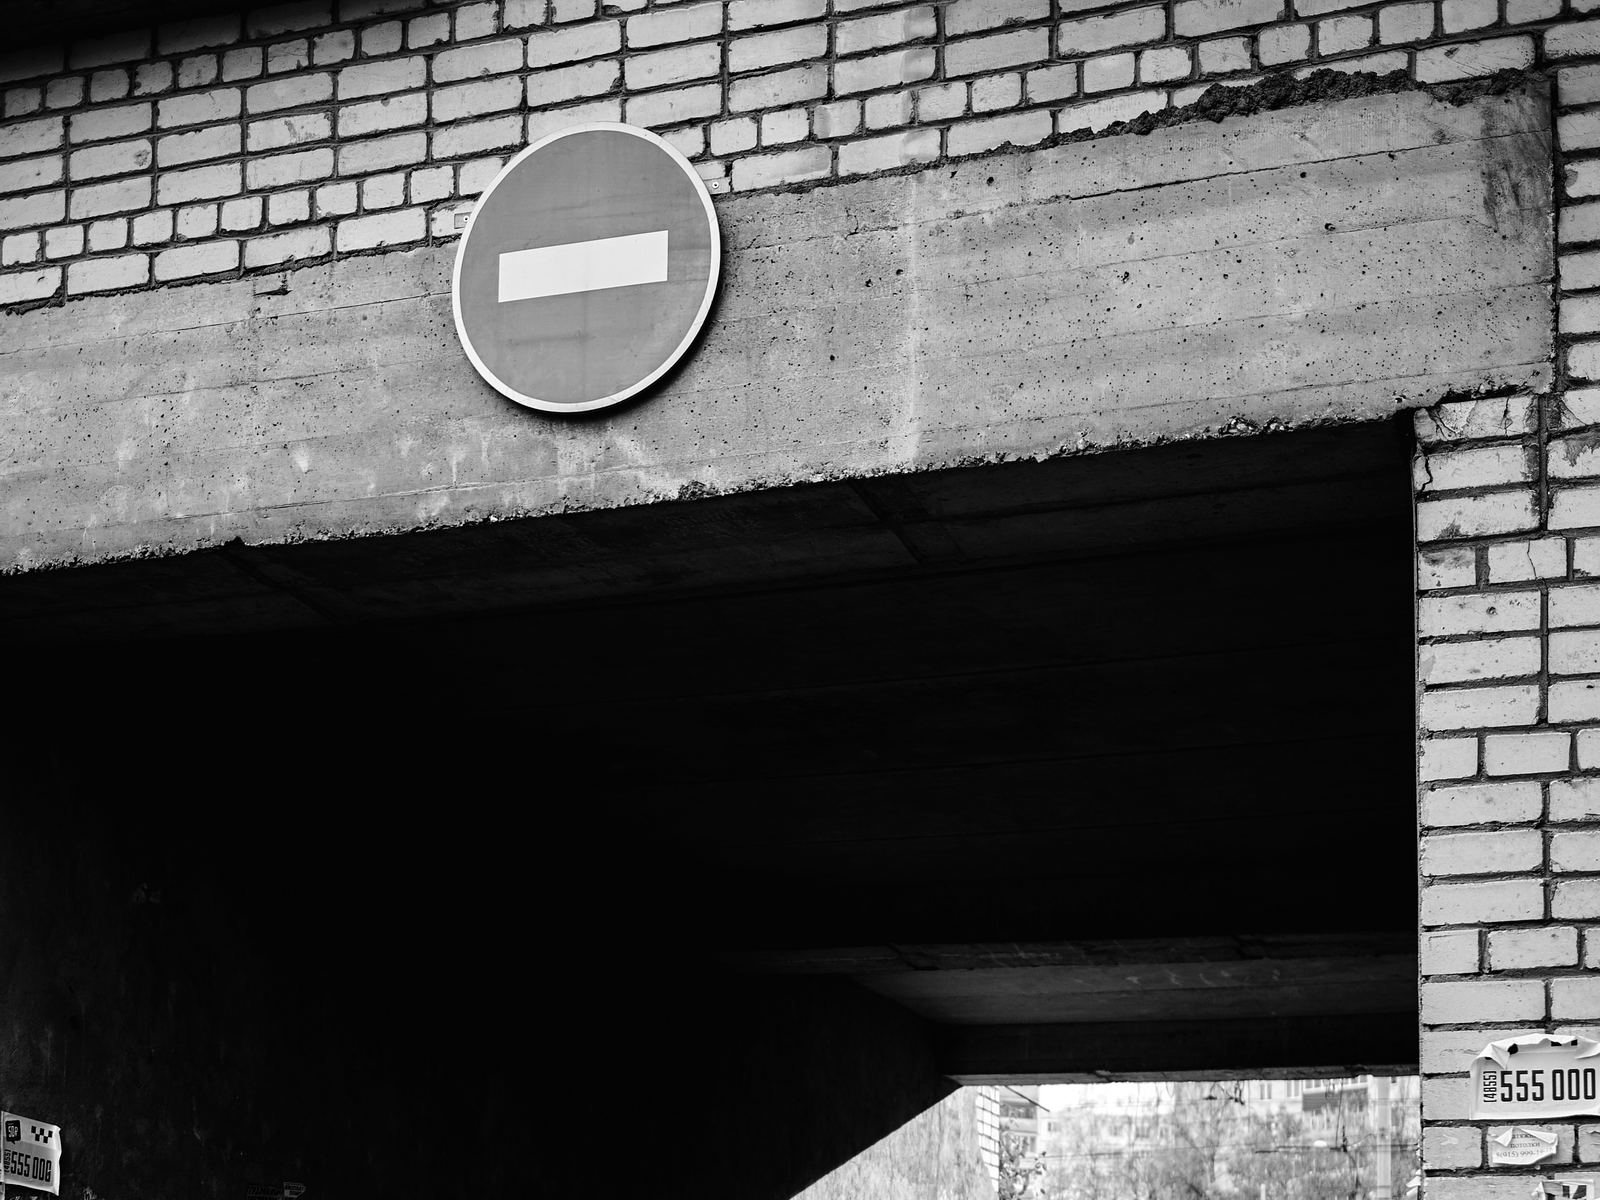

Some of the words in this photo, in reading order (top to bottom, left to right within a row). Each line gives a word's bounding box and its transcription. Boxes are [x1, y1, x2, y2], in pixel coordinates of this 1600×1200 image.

[1500, 1069, 1544, 1102] 555
[1552, 1068, 1596, 1101] 000
[11, 1151, 31, 1177] 555
[32, 1156, 52, 1183] 000
